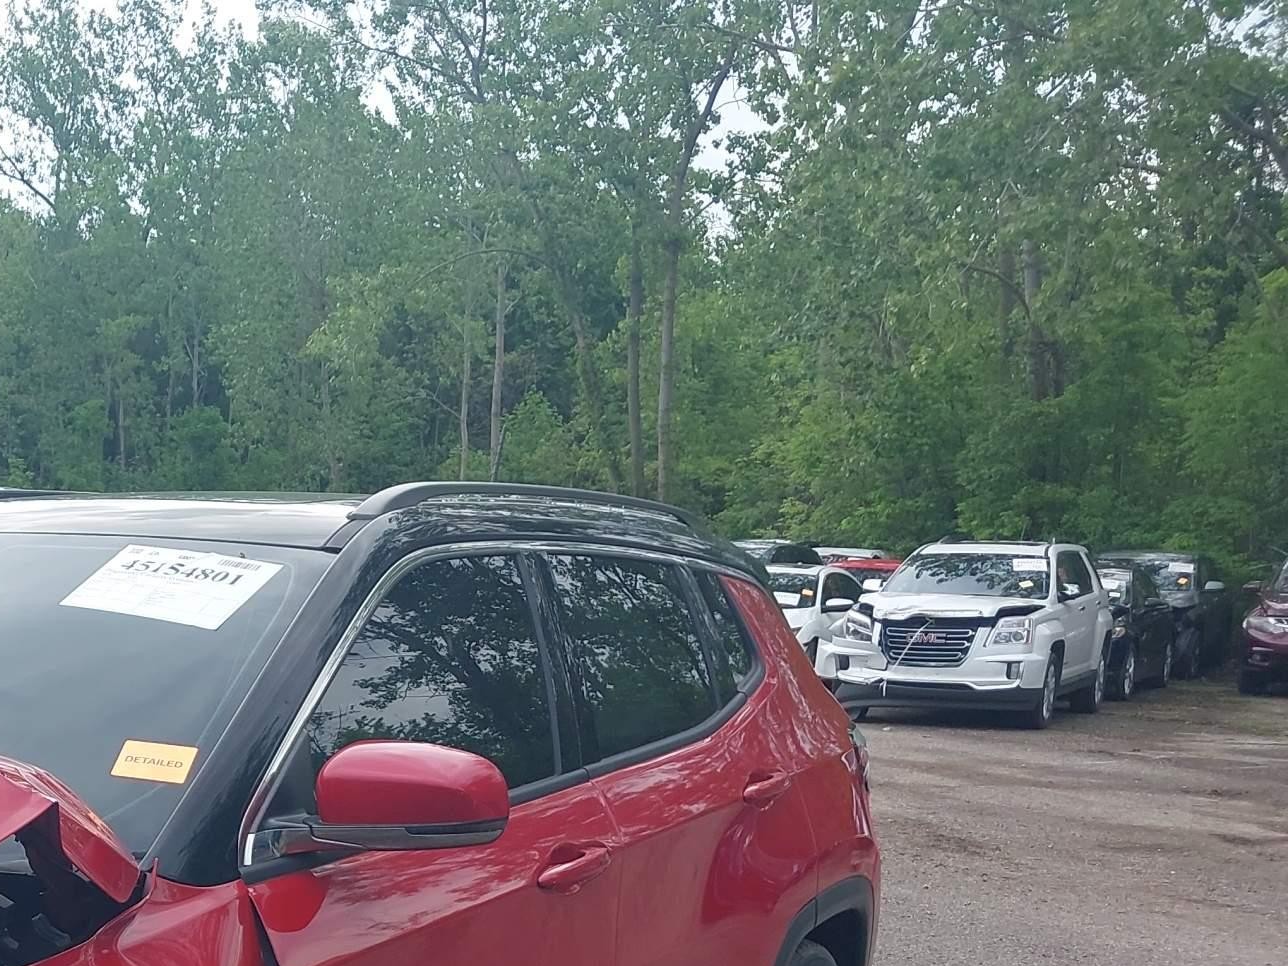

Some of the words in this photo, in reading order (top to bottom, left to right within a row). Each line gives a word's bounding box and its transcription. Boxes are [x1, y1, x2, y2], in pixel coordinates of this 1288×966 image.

[120, 558, 244, 586] 45154801
[905, 632, 947, 644] GMC
[124, 755, 184, 769] DETAILED
